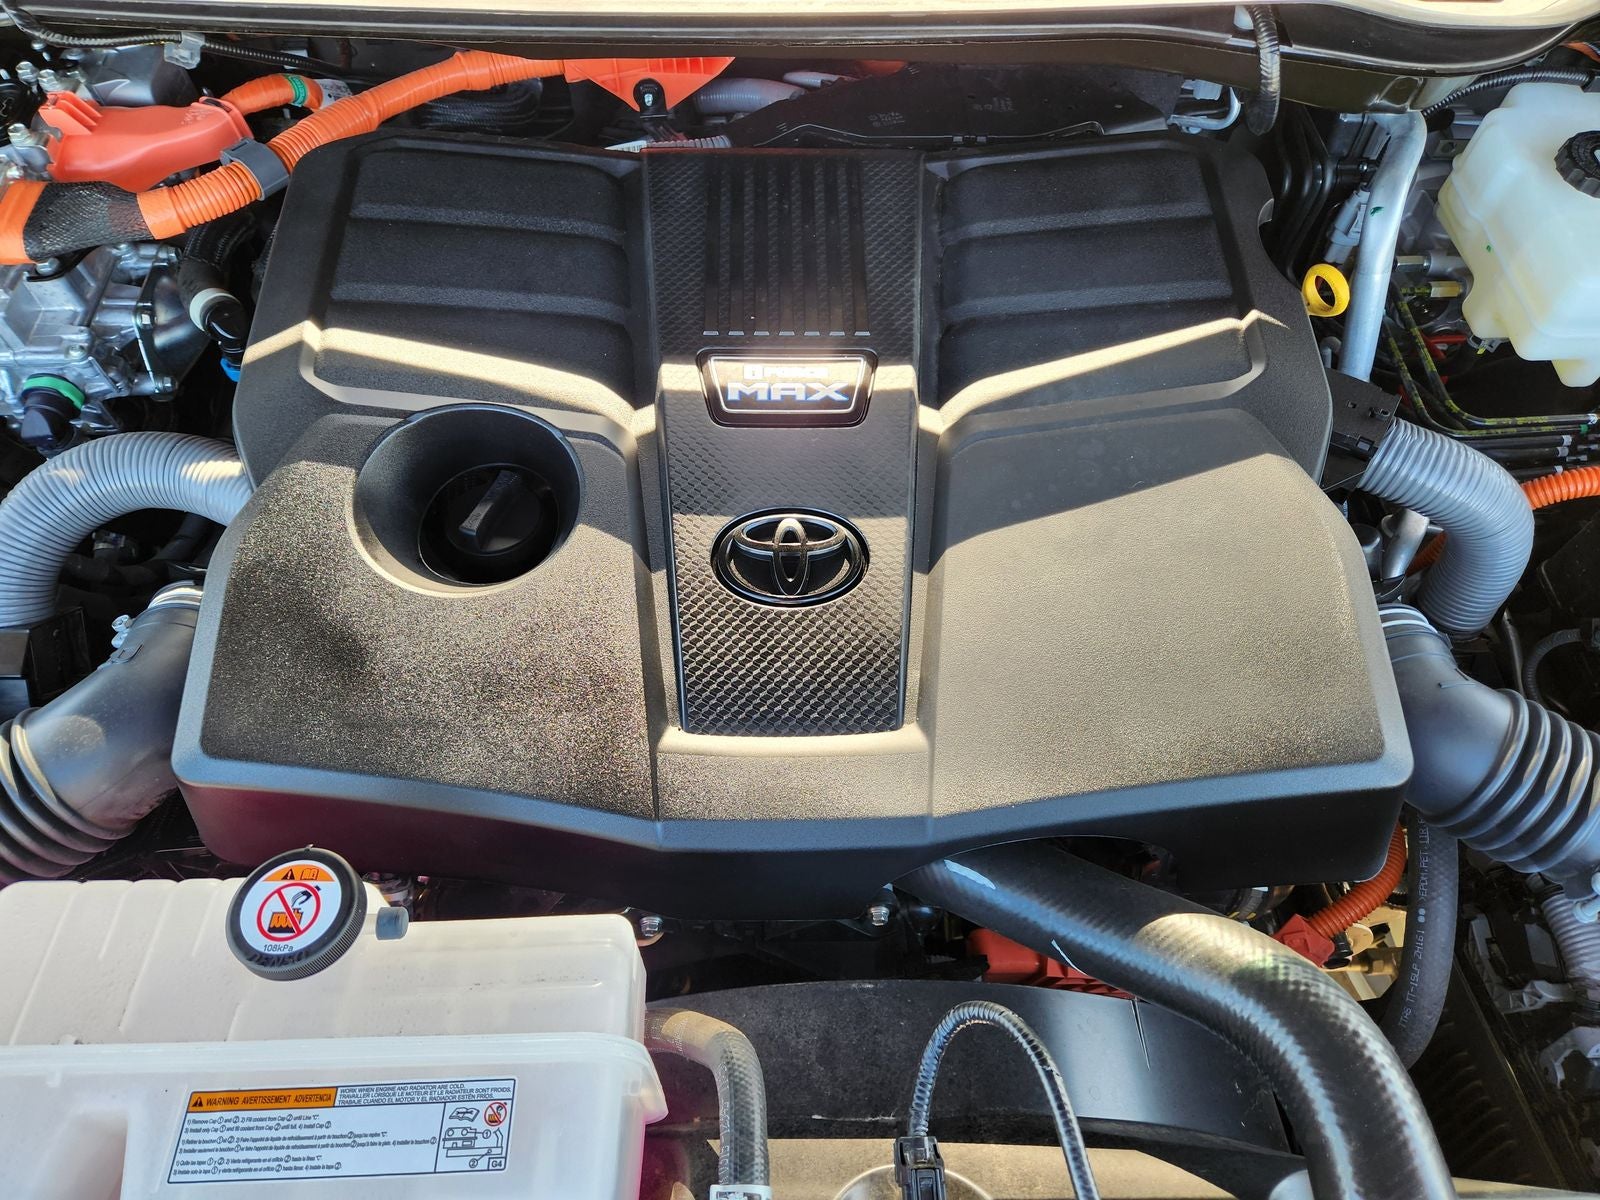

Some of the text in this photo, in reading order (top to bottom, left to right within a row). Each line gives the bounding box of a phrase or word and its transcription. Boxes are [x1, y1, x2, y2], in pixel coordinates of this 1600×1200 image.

[727, 382, 849, 400] MAX
[206, 1093, 332, 1106] WARNING AVERTISSEMENT ADVERTENCIA
[492, 1160, 502, 1168] G4
